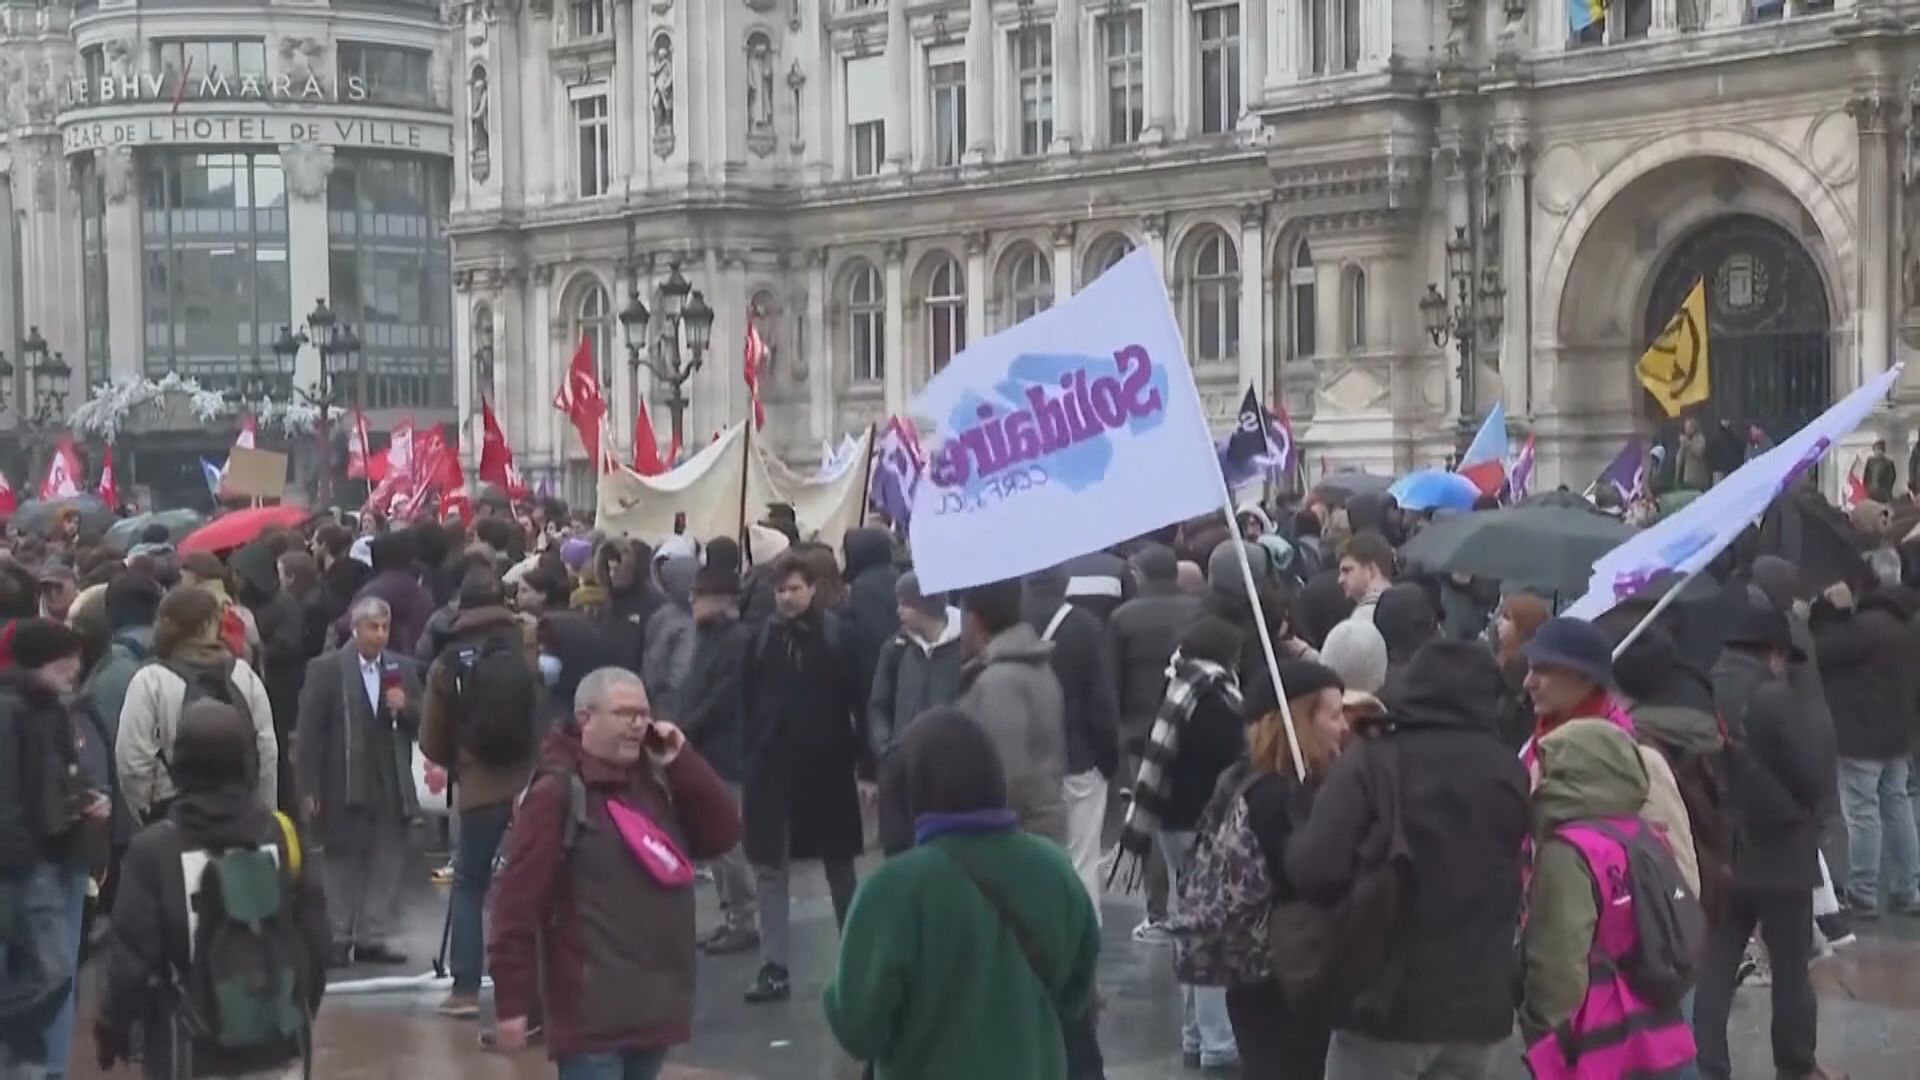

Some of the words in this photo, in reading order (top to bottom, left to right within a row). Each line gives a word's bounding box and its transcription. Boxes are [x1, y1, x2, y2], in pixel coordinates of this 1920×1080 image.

[101, 73, 164, 100] BHV
[200, 72, 366, 101] MARAIS
[115, 123, 136, 143] DE
[290, 123, 321, 142] DE
[335, 120, 422, 147] VILLE
